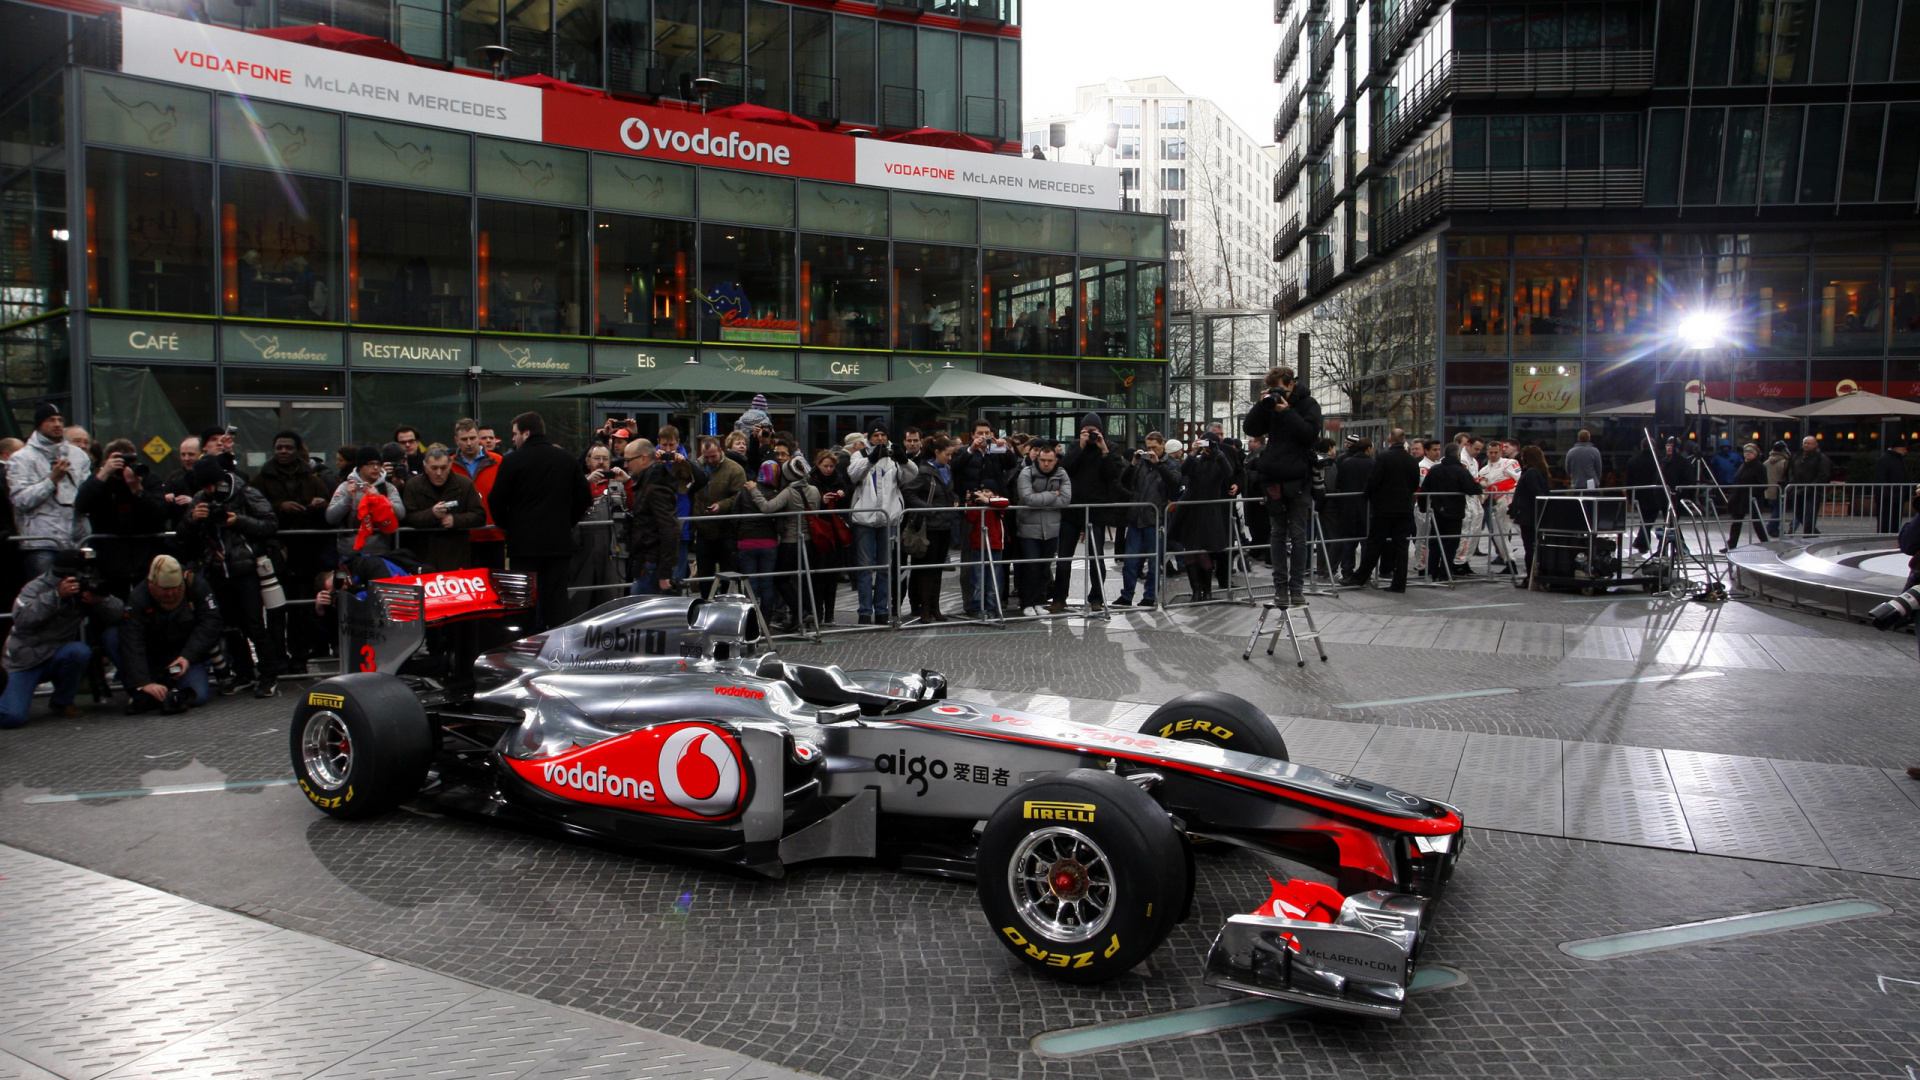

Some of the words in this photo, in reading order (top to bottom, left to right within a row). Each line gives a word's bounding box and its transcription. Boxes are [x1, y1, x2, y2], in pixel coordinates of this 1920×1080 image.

[173, 48, 292, 84] VODAFONE
[304, 73, 400, 102] McLAREN
[407, 92, 508, 120] MERCEDES
[652, 127, 791, 166] vodafone
[883, 162, 956, 180] VODAFONE
[962, 172, 1024, 188] McLAREN
[1028, 178, 1096, 195] MERCEDES
[129, 331, 180, 351] CAFÉ
[262, 344, 329, 362] Corroboree
[362, 341, 462, 362] RESTAURANT
[516, 356, 571, 371] Corroboree
[830, 360, 860, 375] CAFÉ
[1515, 365, 1577, 374] REAURNT
[583, 625, 641, 653] Mobil
[360, 644, 377, 673] 3
[308, 692, 345, 709] PIRELLI
[713, 685, 765, 700] vodafone
[1158, 718, 1234, 740] ZERO
[543, 762, 656, 801] vodafone
[874, 748, 948, 797] aigo
[953, 762, 1011, 787] 爱国者
[299, 779, 342, 808] ZERO
[1023, 800, 1096, 823] PIRELLI
[1002, 926, 1095, 969] ZERO
[1104, 933, 1121, 959] P
